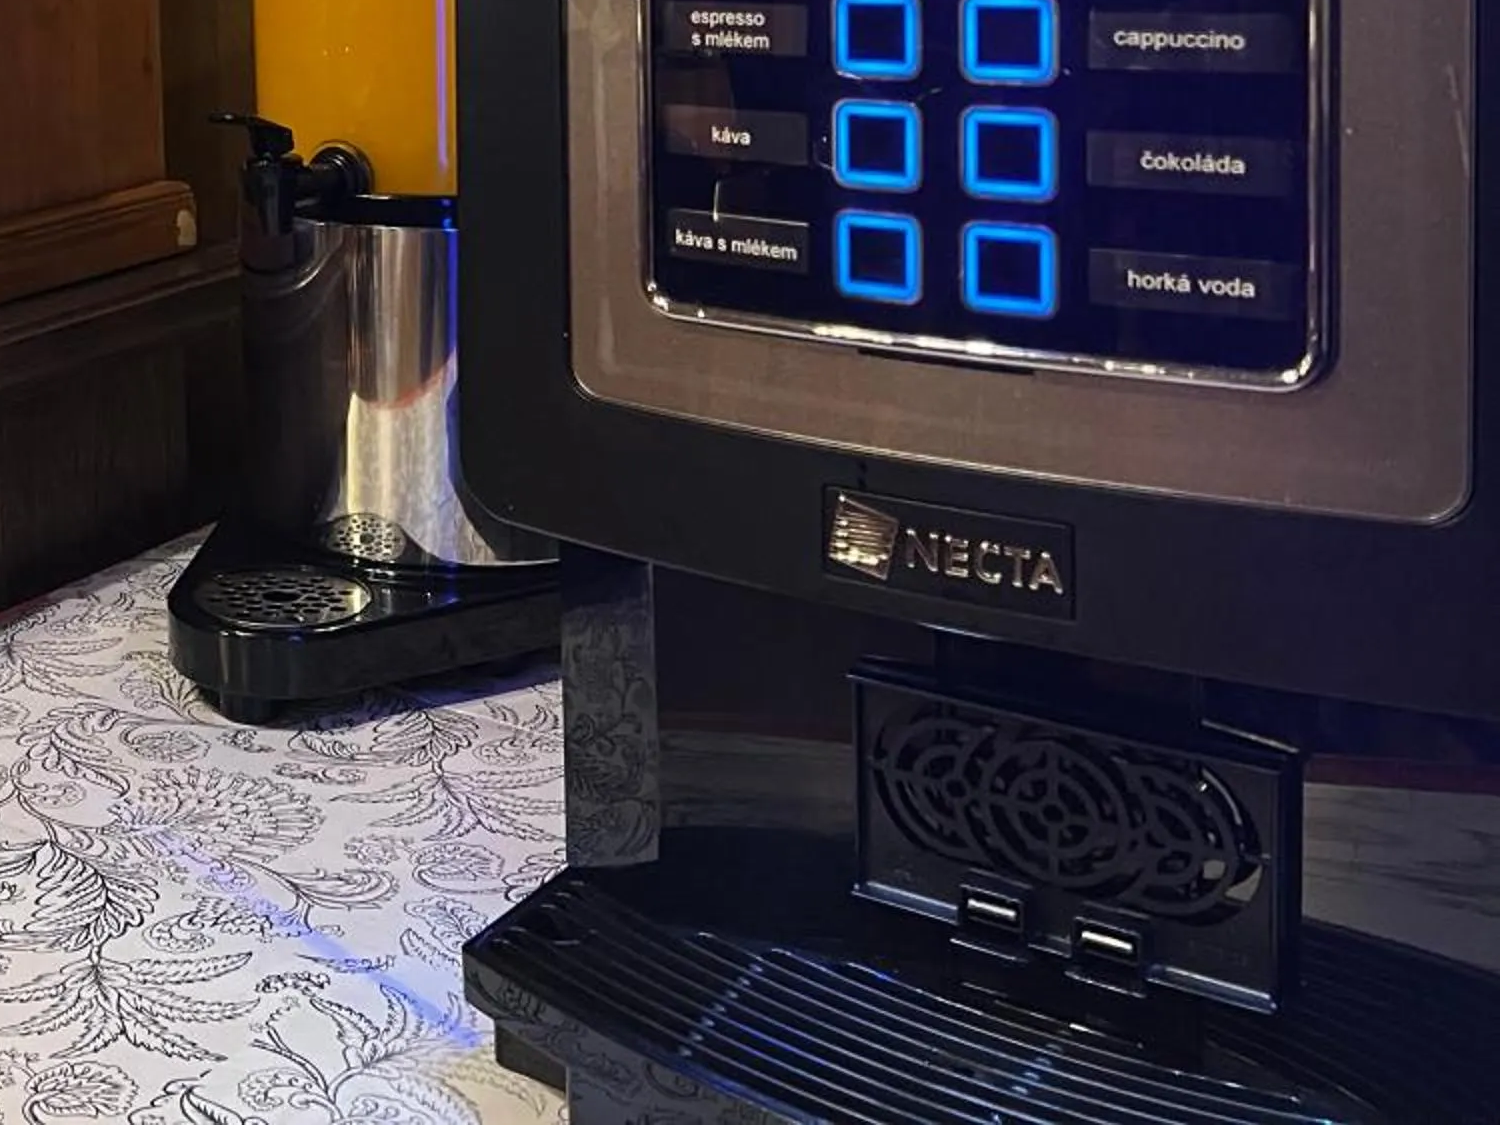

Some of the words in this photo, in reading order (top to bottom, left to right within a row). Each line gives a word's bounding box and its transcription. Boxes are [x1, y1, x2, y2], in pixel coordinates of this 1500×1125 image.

[690, 10, 766, 28] espresso
[691, 35, 702, 47] s
[705, 30, 771, 50] mlékem
[1113, 29, 1246, 52] cappuccino
[711, 125, 752, 146] káva
[1140, 150, 1246, 175] čokoláda
[674, 228, 714, 250] káva
[717, 239, 727, 252] s
[731, 236, 799, 261] mlékem
[1126, 269, 1191, 294] horká
[1198, 277, 1256, 299] voda
[905, 528, 1065, 595] NECTA
